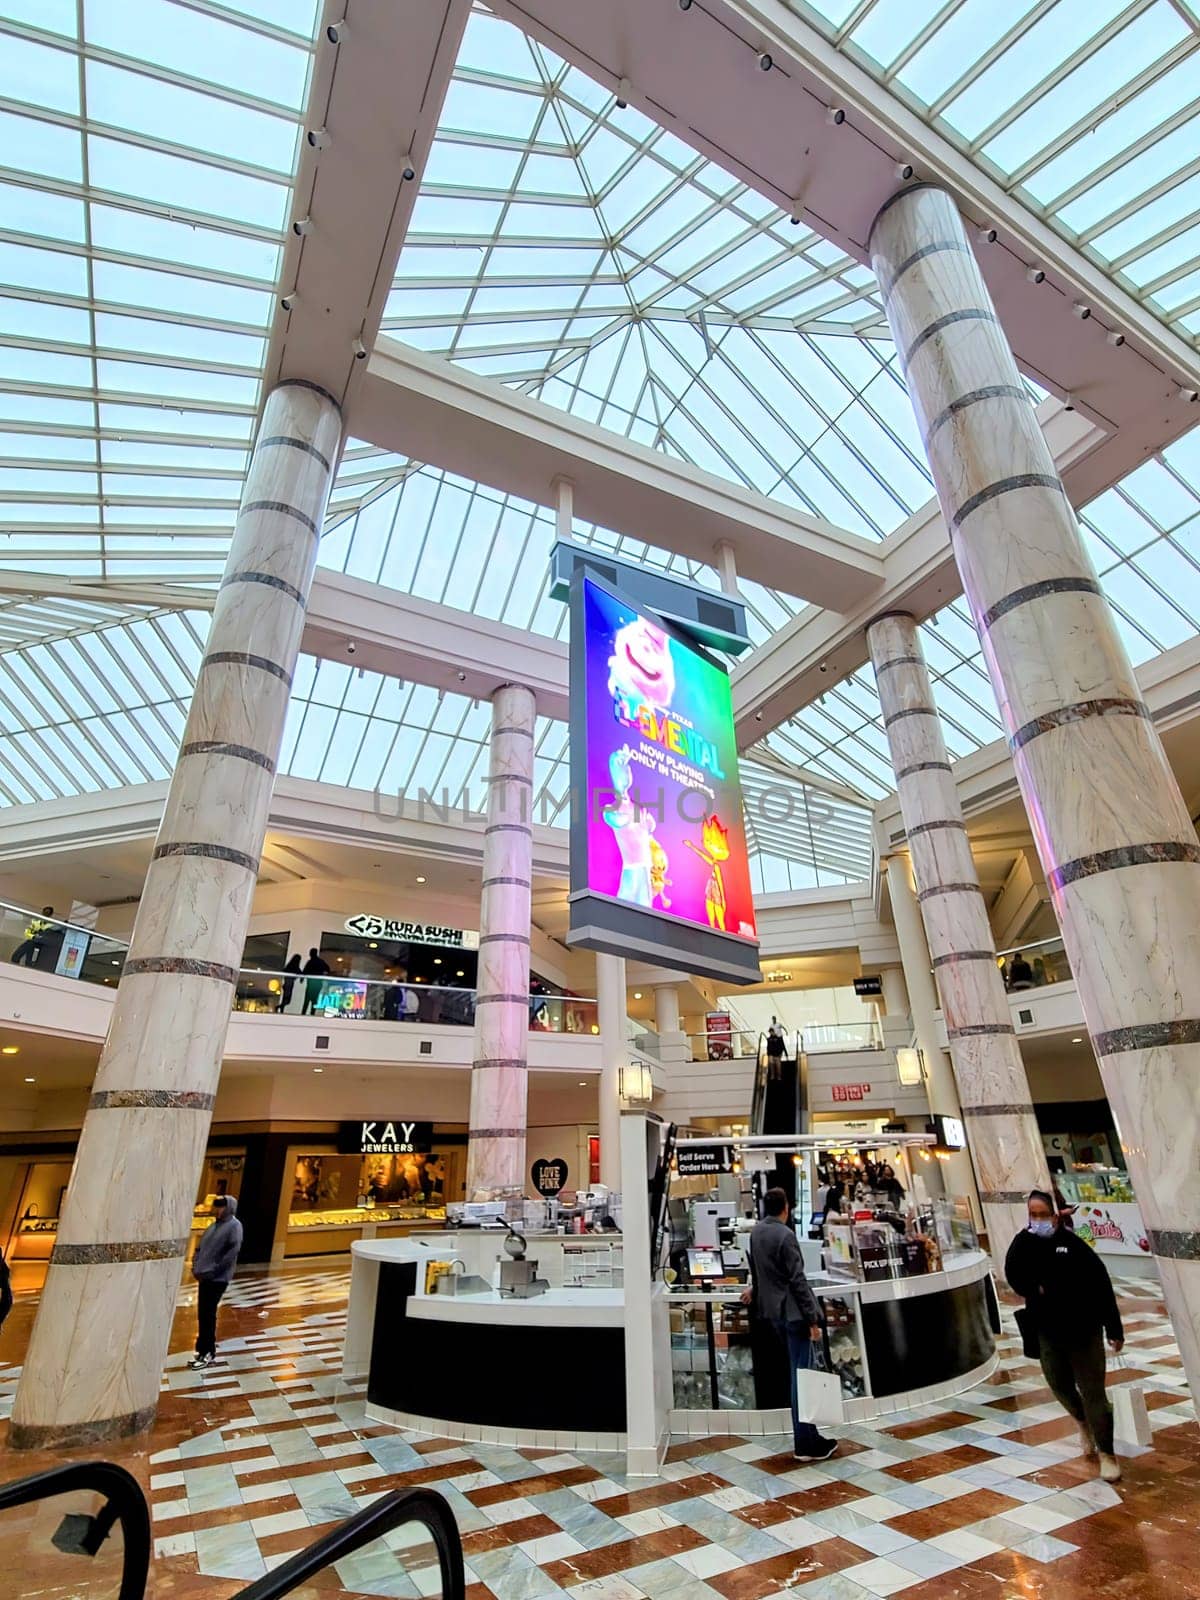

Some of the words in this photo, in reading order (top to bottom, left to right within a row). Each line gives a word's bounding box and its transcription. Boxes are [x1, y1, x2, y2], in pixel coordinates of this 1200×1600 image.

[629, 748, 657, 770] ONLY
[658, 762, 669, 777] IN
[639, 741, 665, 762] NOW
[665, 754, 705, 783] PLAYING
[384, 919, 423, 936] KURA
[425, 925, 463, 940] SUSHI
[361, 1122, 416, 1143] KAY
[361, 1143, 413, 1152] JEWELERS
[679, 1153, 693, 1161] Self
[694, 1153, 715, 1161] Serve
[539, 1166, 560, 1178] LOVE
[679, 1164, 701, 1172] Order
[701, 1162, 720, 1171] Here
[539, 1178, 560, 1190] PINK
[863, 1259, 878, 1270] PICK
